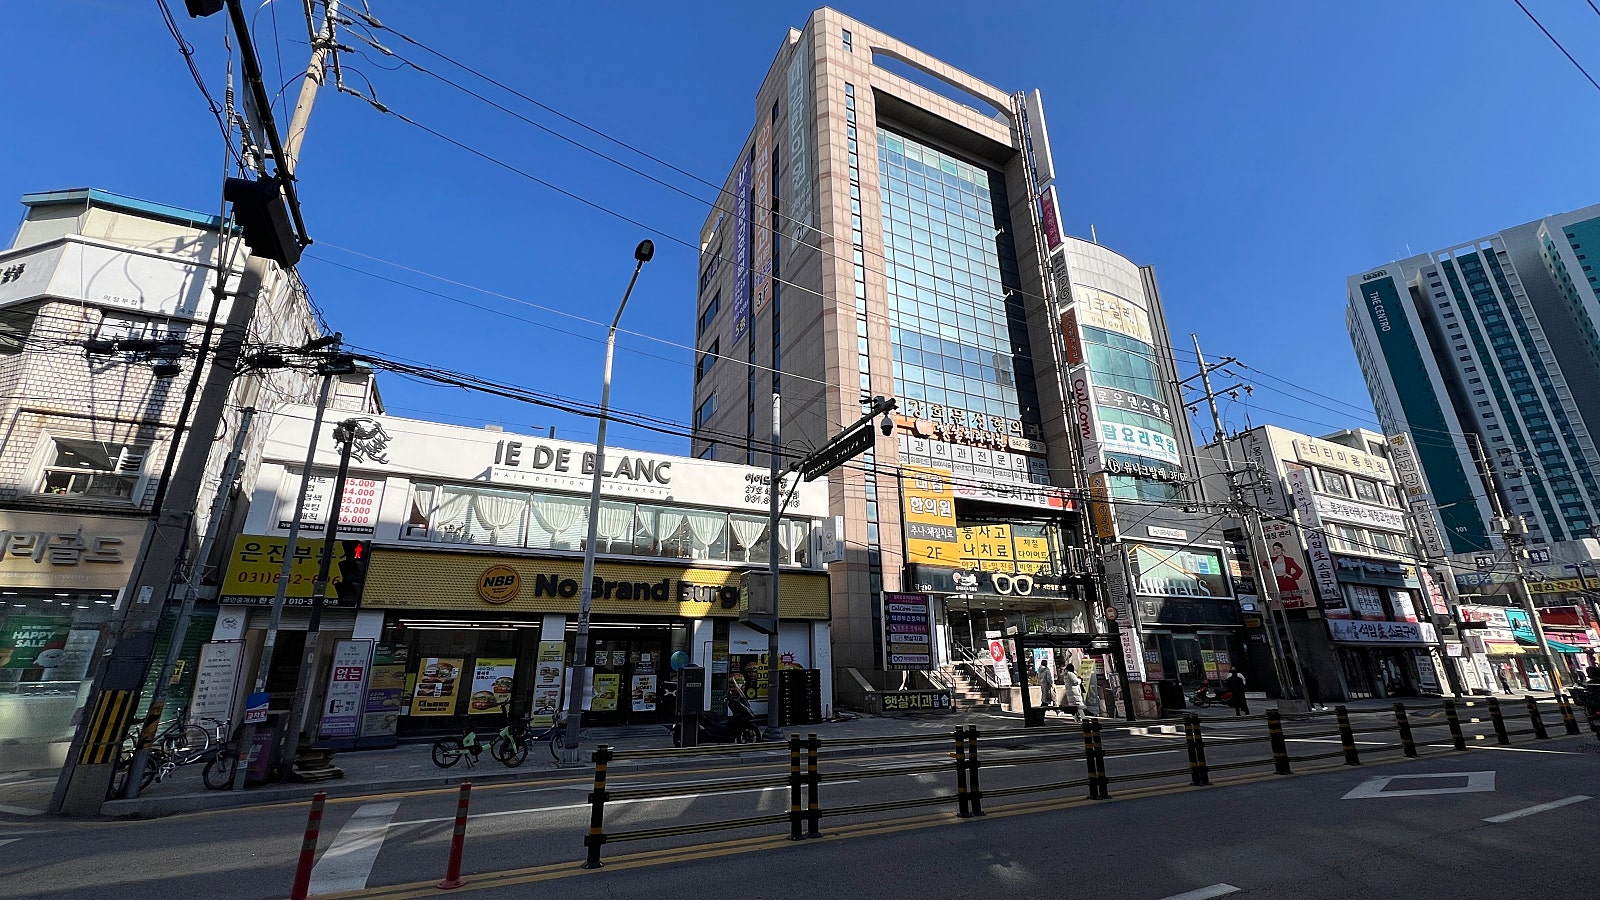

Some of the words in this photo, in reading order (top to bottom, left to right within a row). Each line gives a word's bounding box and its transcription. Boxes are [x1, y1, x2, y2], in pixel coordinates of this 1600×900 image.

[1370, 291, 1380, 307] THE
[1374, 307, 1391, 332] CENTRO
[494, 439, 521, 466] IE
[533, 444, 571, 472] DE
[582, 451, 672, 485] BLANC
[494, 471, 526, 480] HAIR
[535, 476, 585, 487] DESIGN
[600, 482, 673, 496] ABORATORY
[910, 497, 952, 518] 한의원
[1278, 529, 1292, 539] 관리
[926, 546, 943, 560] 2F
[483, 575, 515, 587] NBB
[534, 573, 578, 598] No
[677, 581, 741, 609] Burg
[12, 631, 56, 639] HAPPY
[15, 640, 47, 648] SALE
[336, 667, 361, 680] 없는
[884, 693, 932, 710] 햇살치과
[247, 710, 266, 720] 교차로
